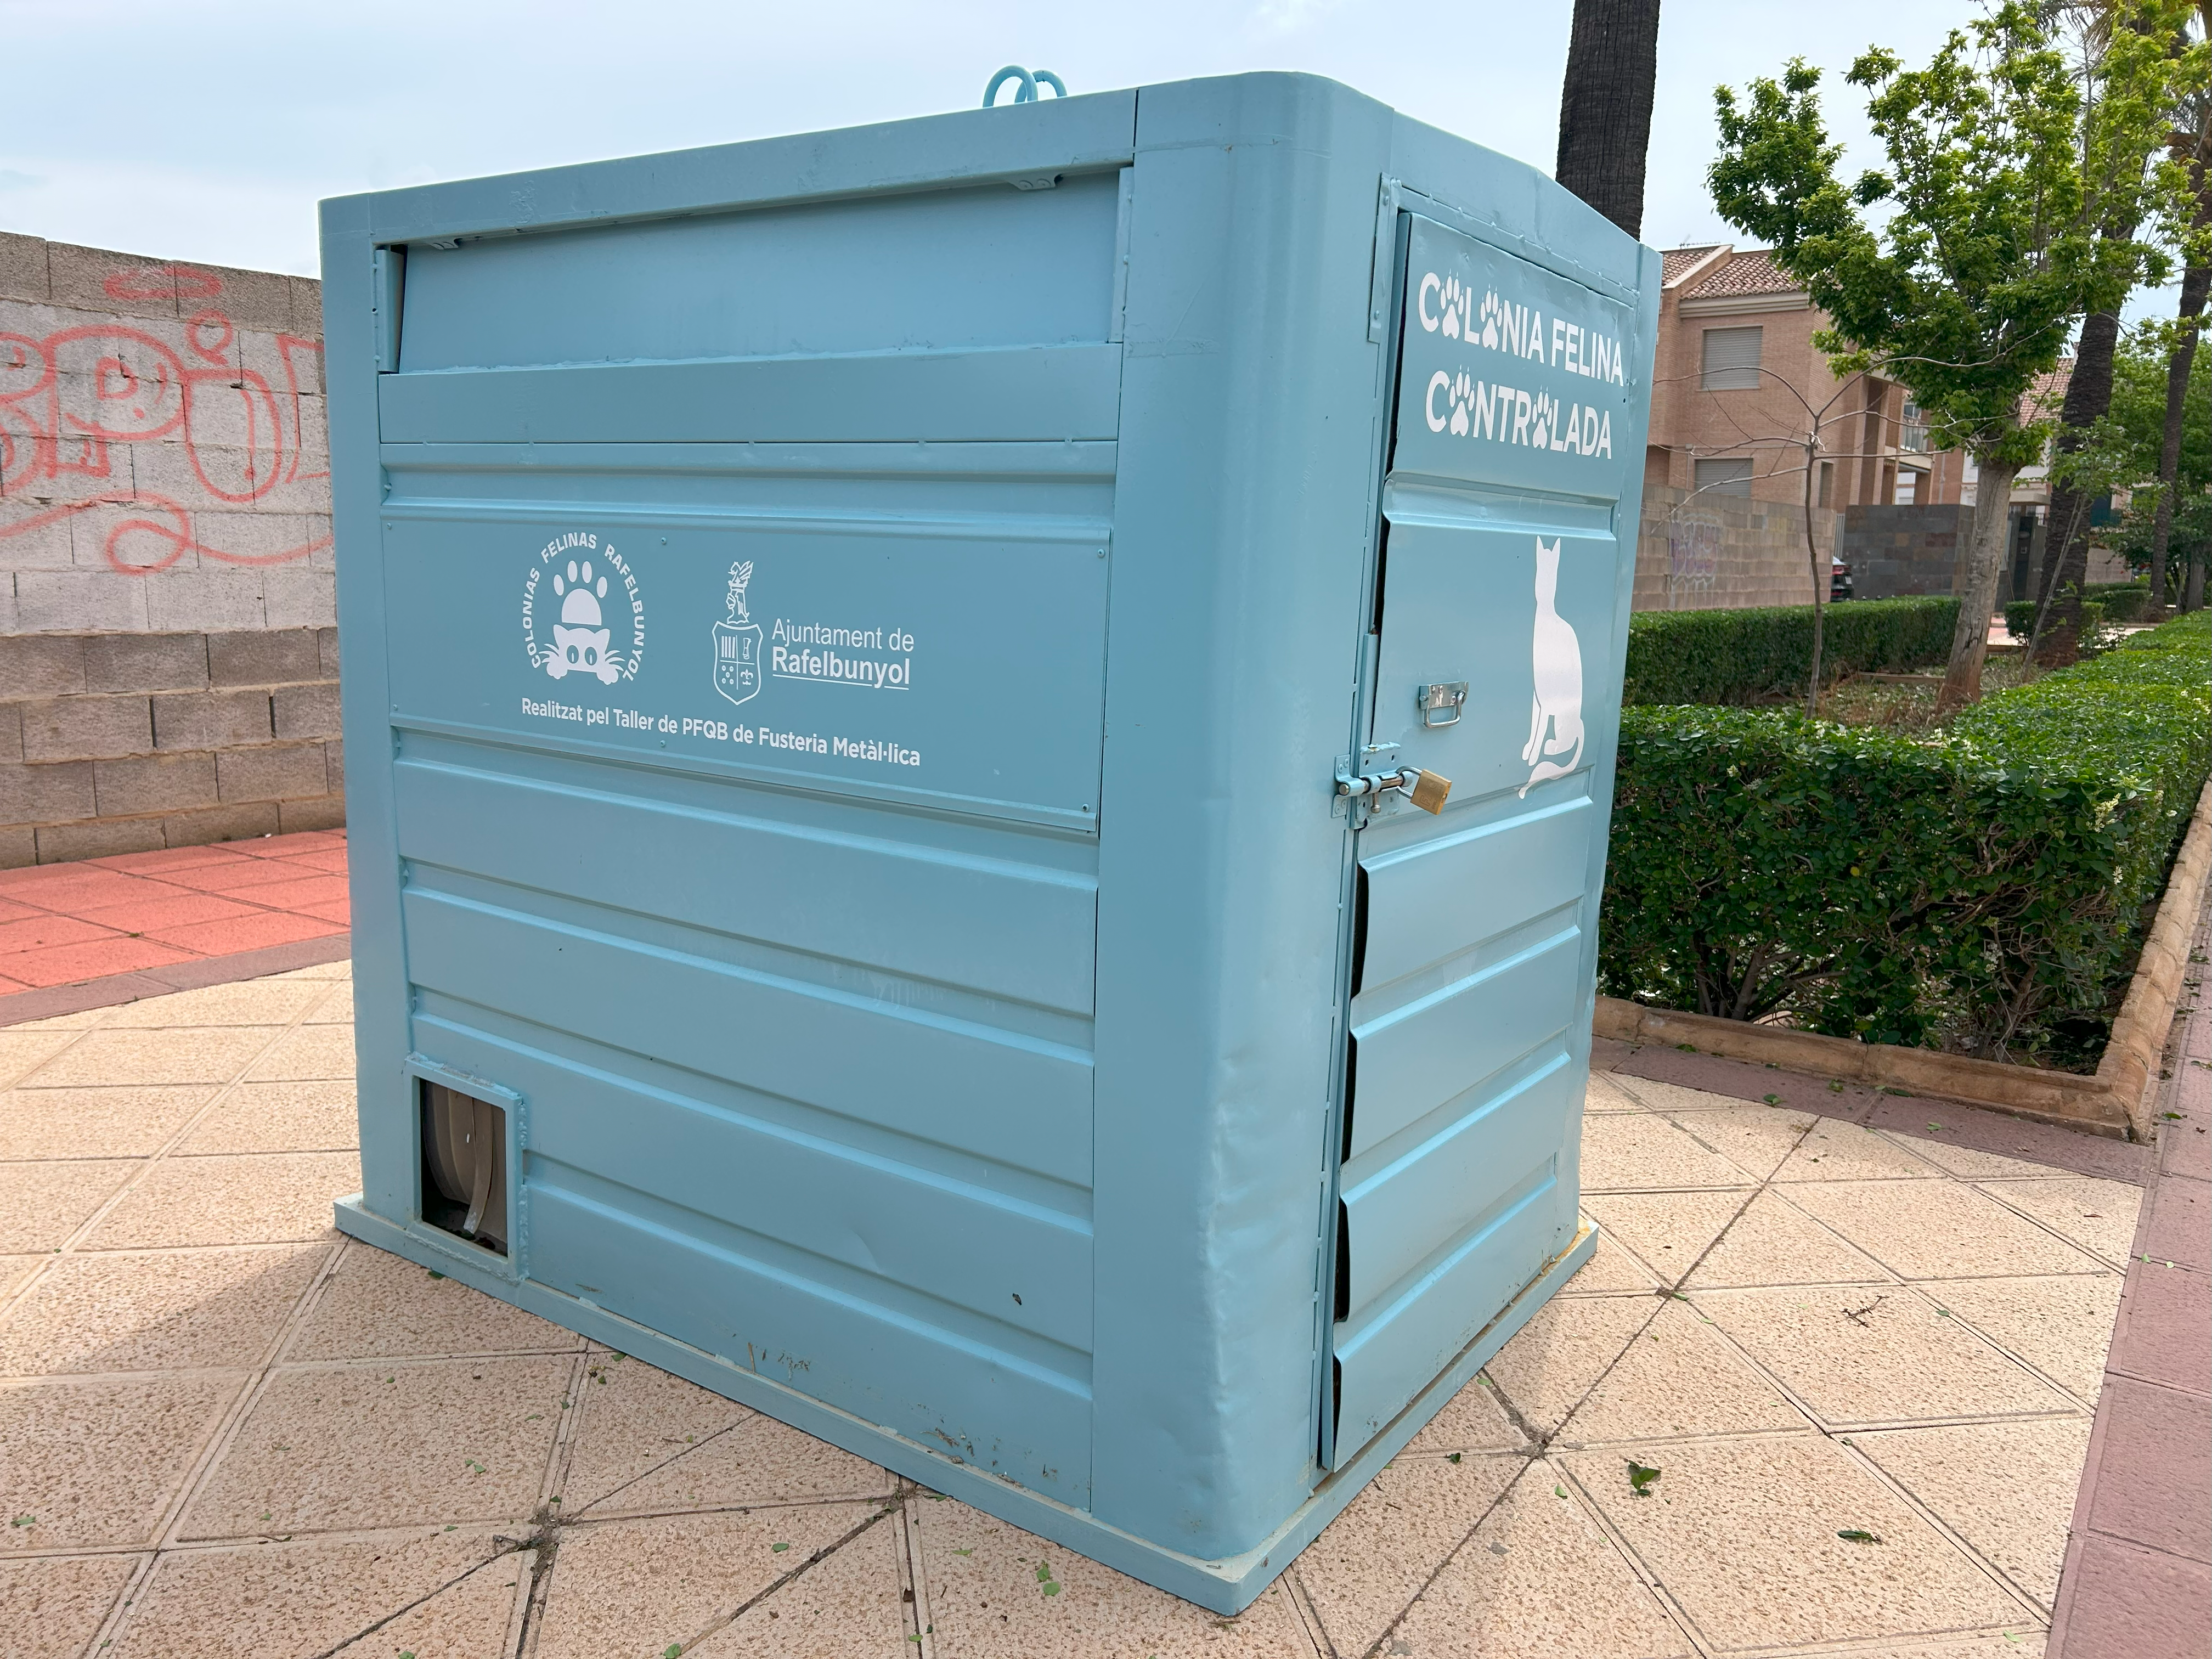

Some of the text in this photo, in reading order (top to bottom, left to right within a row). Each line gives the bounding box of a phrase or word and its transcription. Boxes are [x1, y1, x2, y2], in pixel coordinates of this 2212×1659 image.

[1551, 318, 1624, 387] FELINA
[522, 532, 645, 681] COLONIAS FELINAS RAFELBUNYOL
[771, 618, 915, 652] Ajuntament de
[772, 646, 910, 689] Rafelbunyol
[521, 697, 583, 721] Realitzat
[586, 707, 610, 726] pel
[613, 708, 654, 730] Taller
[658, 714, 678, 734] de
[682, 718, 729, 741] PFQB
[732, 724, 754, 744] de
[759, 727, 828, 754] Fusteria
